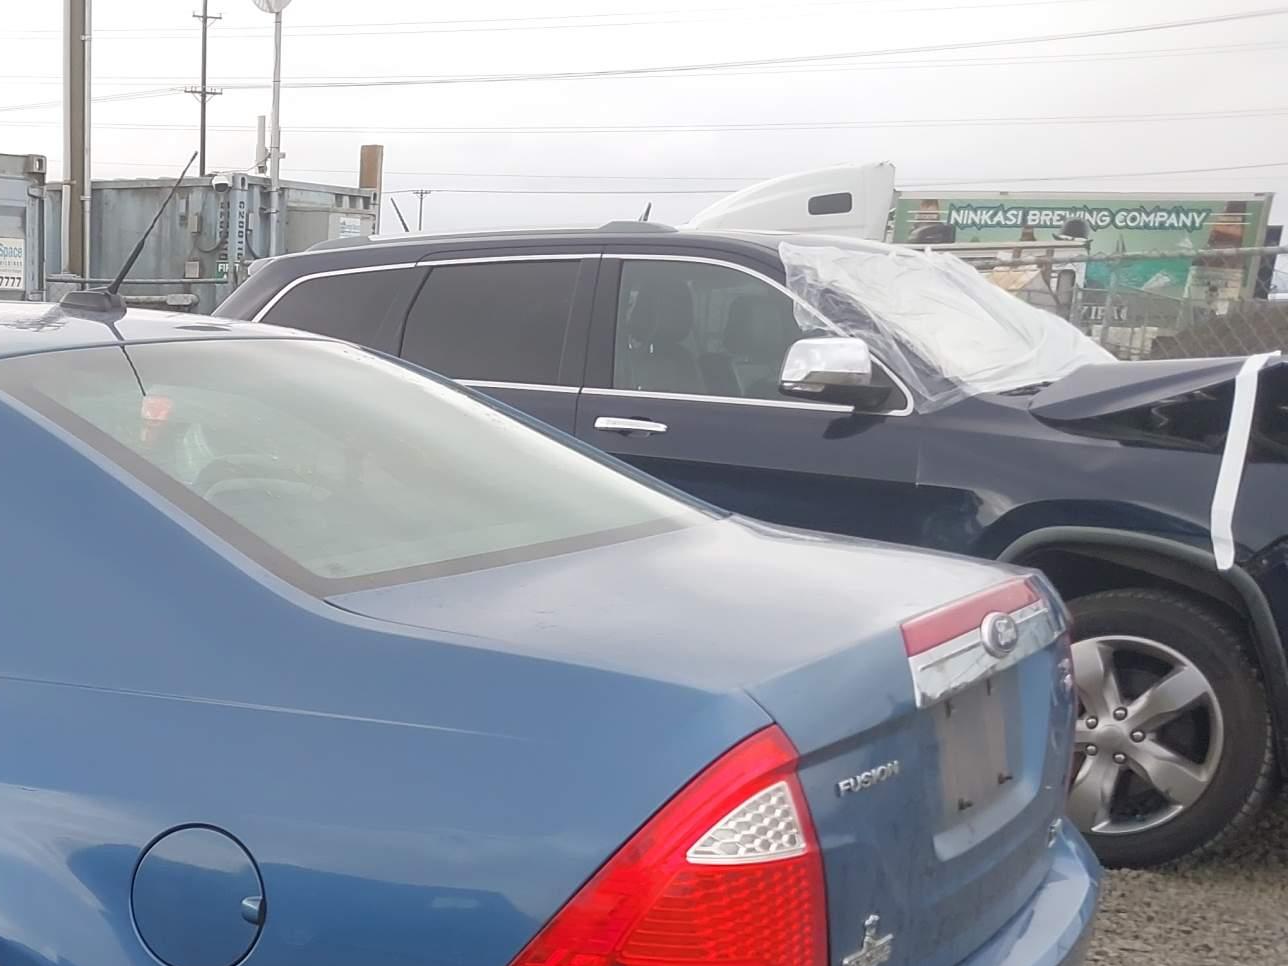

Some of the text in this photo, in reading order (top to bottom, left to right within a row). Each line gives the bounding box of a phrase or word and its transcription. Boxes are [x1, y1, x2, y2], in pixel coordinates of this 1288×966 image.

[950, 209, 1023, 225] NINKASI
[1115, 211, 1206, 227] COMPANY
[838, 760, 899, 796] FUSION
